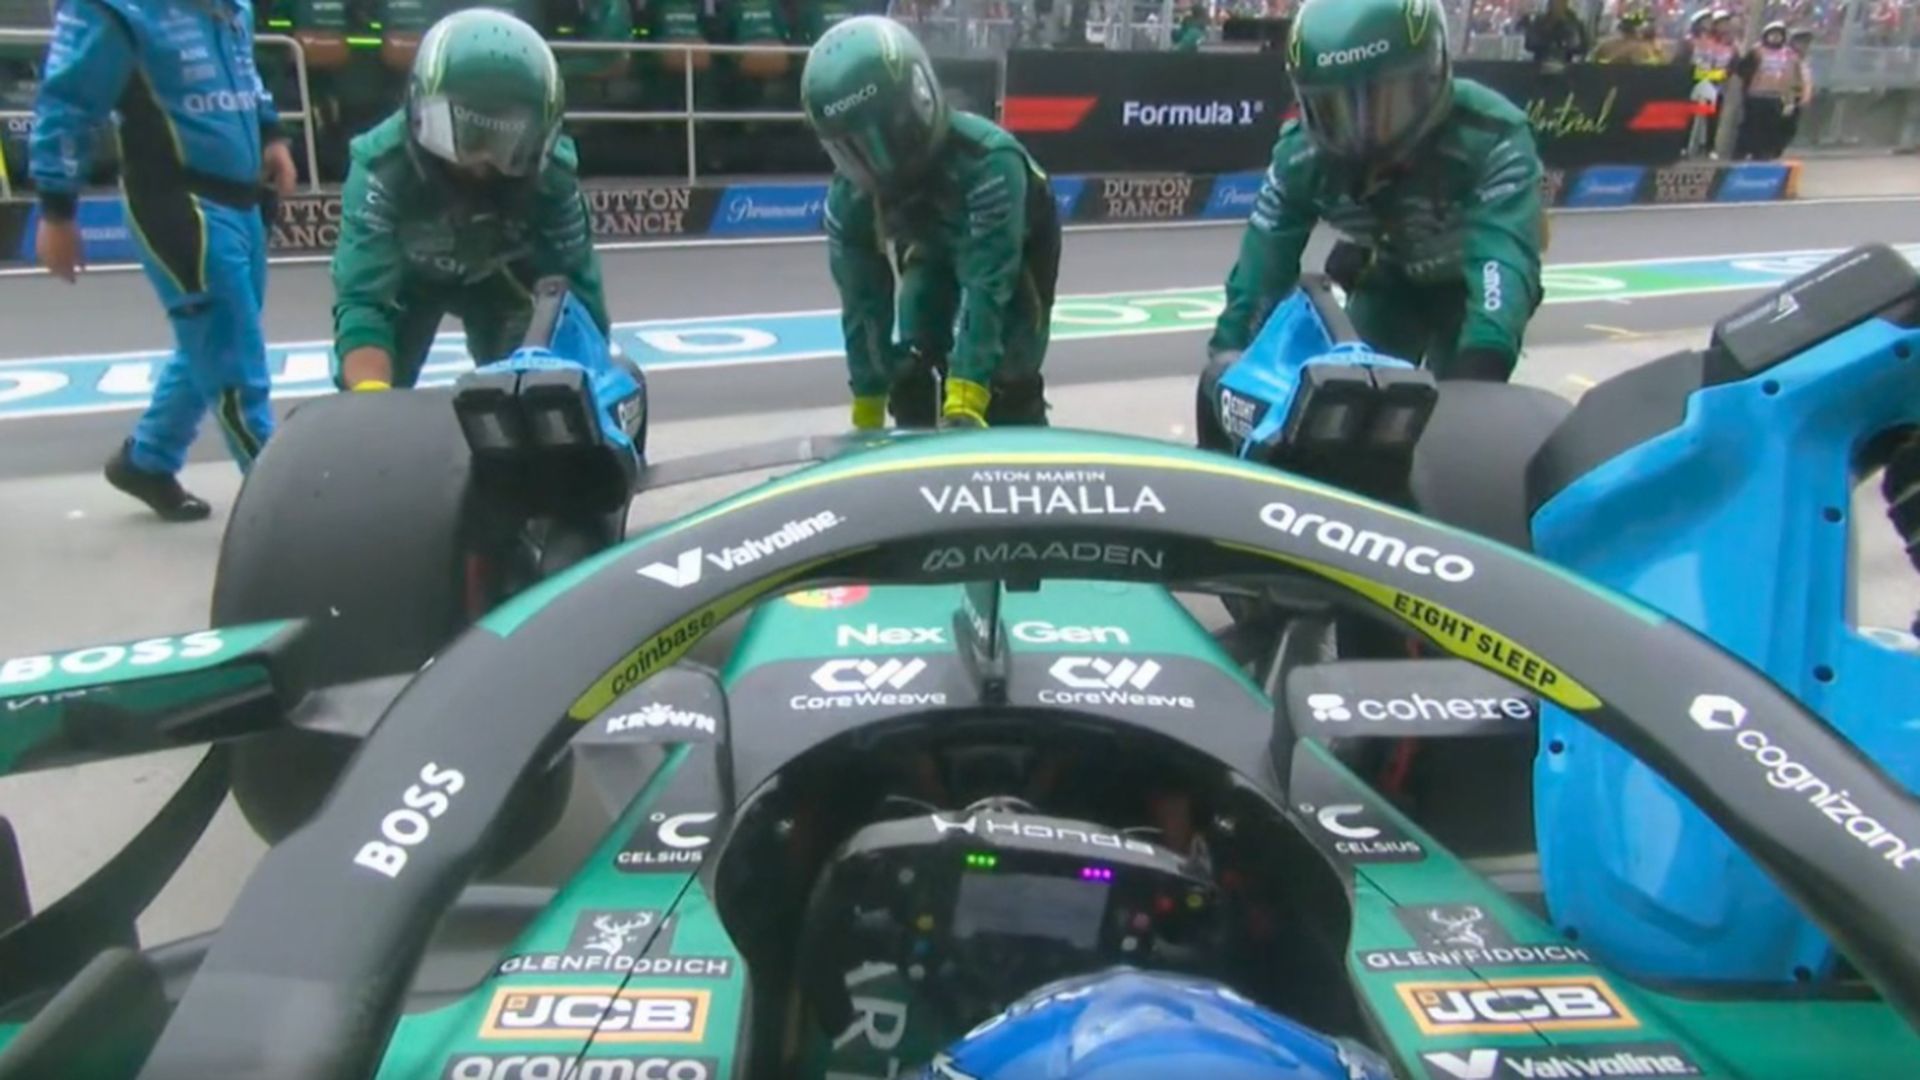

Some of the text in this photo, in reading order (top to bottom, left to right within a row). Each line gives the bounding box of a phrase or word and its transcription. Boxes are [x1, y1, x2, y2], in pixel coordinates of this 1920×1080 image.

[1317, 39, 1390, 67] aramco
[823, 83, 878, 117] aramco
[1123, 101, 1234, 125] Formula
[1103, 178, 1192, 198] DUTTON
[1109, 198, 1184, 217] RANCH
[268, 223, 341, 247] ANC
[971, 470, 1106, 482] ASTON MARTIN
[920, 485, 1166, 514] VALHALLA
[974, 541, 1165, 570] MAADEN
[1259, 502, 1475, 582] aramco
[836, 621, 1131, 647] Nex Gen
[1393, 592, 1557, 687] EIGHT SLEEP
[0, 630, 224, 684] BOSS
[611, 610, 715, 696] coinbase
[789, 691, 947, 710] CoreWeave
[1037, 690, 1196, 709] CoreWeave
[1357, 693, 1532, 720] cohere
[1735, 730, 1920, 869] cognizant
[353, 761, 466, 878] BOSS
[986, 818, 1156, 857] Honda
[1334, 841, 1421, 855] CELSIUS
[617, 851, 703, 864] CELSIUS
[500, 995, 693, 1032] JCB
[1424, 985, 1613, 1022] JCB
